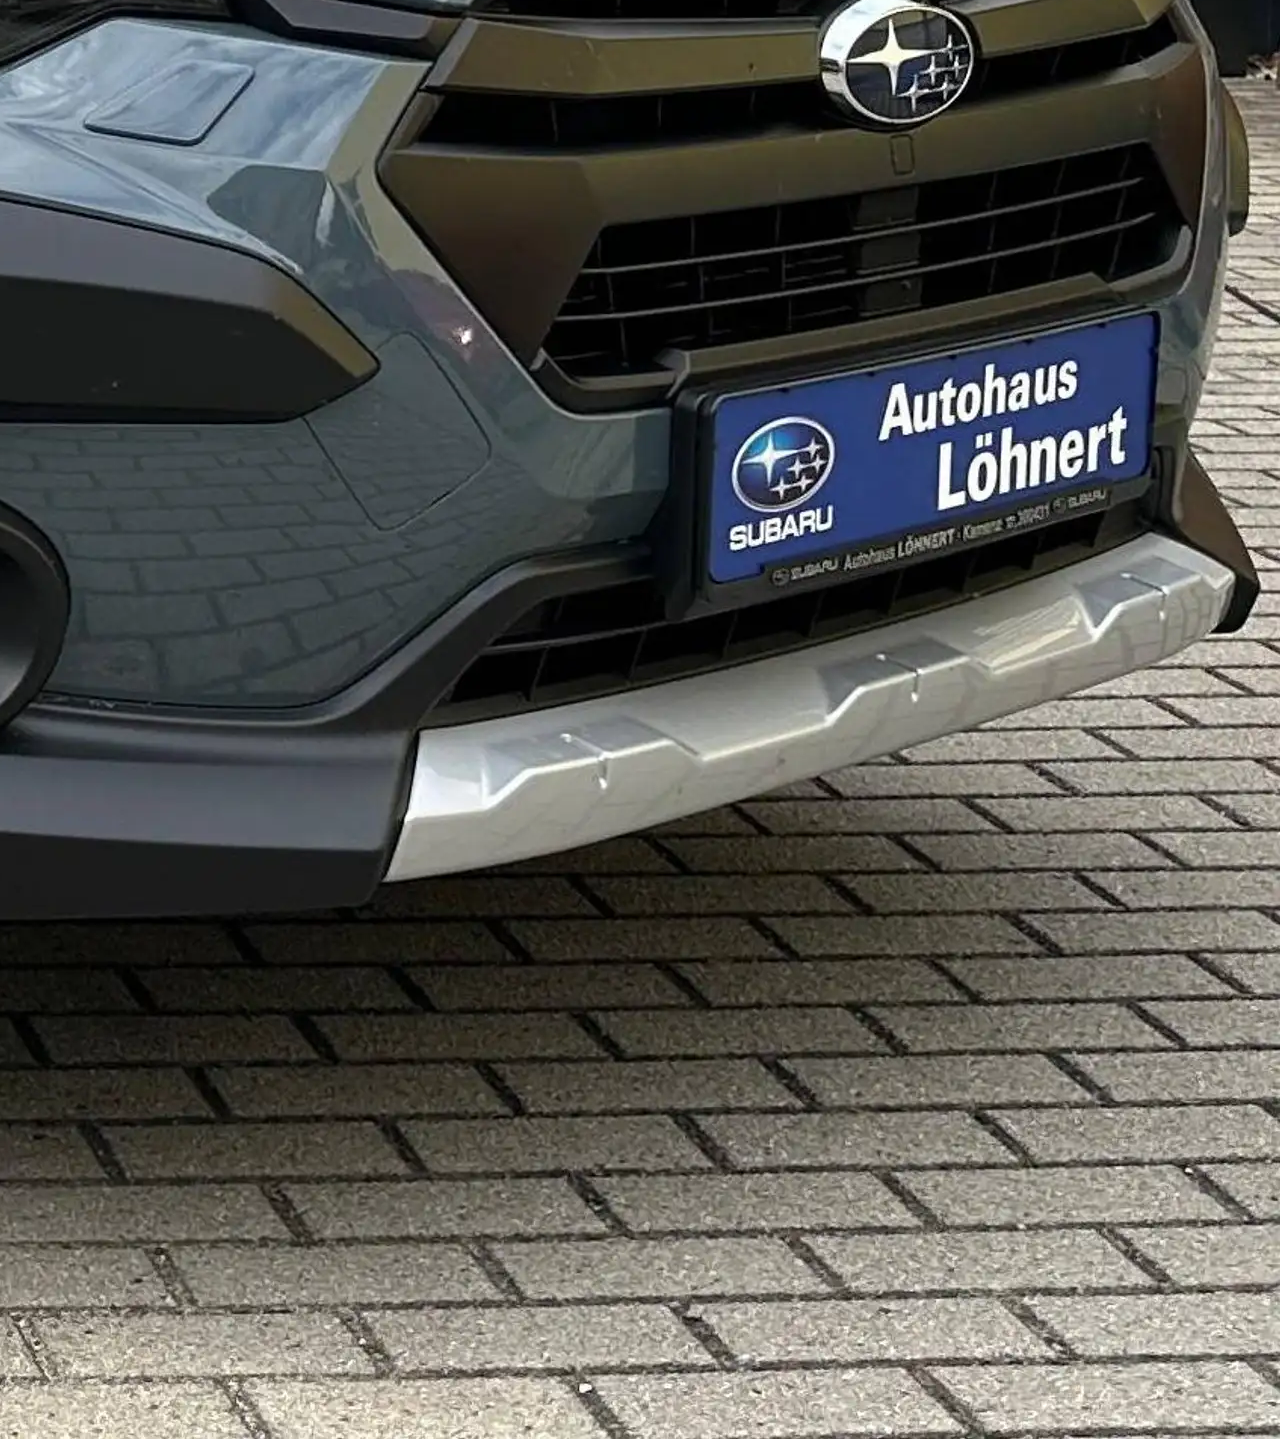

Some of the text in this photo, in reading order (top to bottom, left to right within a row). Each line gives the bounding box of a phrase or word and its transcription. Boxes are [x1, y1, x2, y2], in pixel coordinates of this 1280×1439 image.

[878, 359, 1079, 442] Autohaus
[936, 405, 1128, 512] Löhnert
[729, 504, 834, 552] SUBARU
